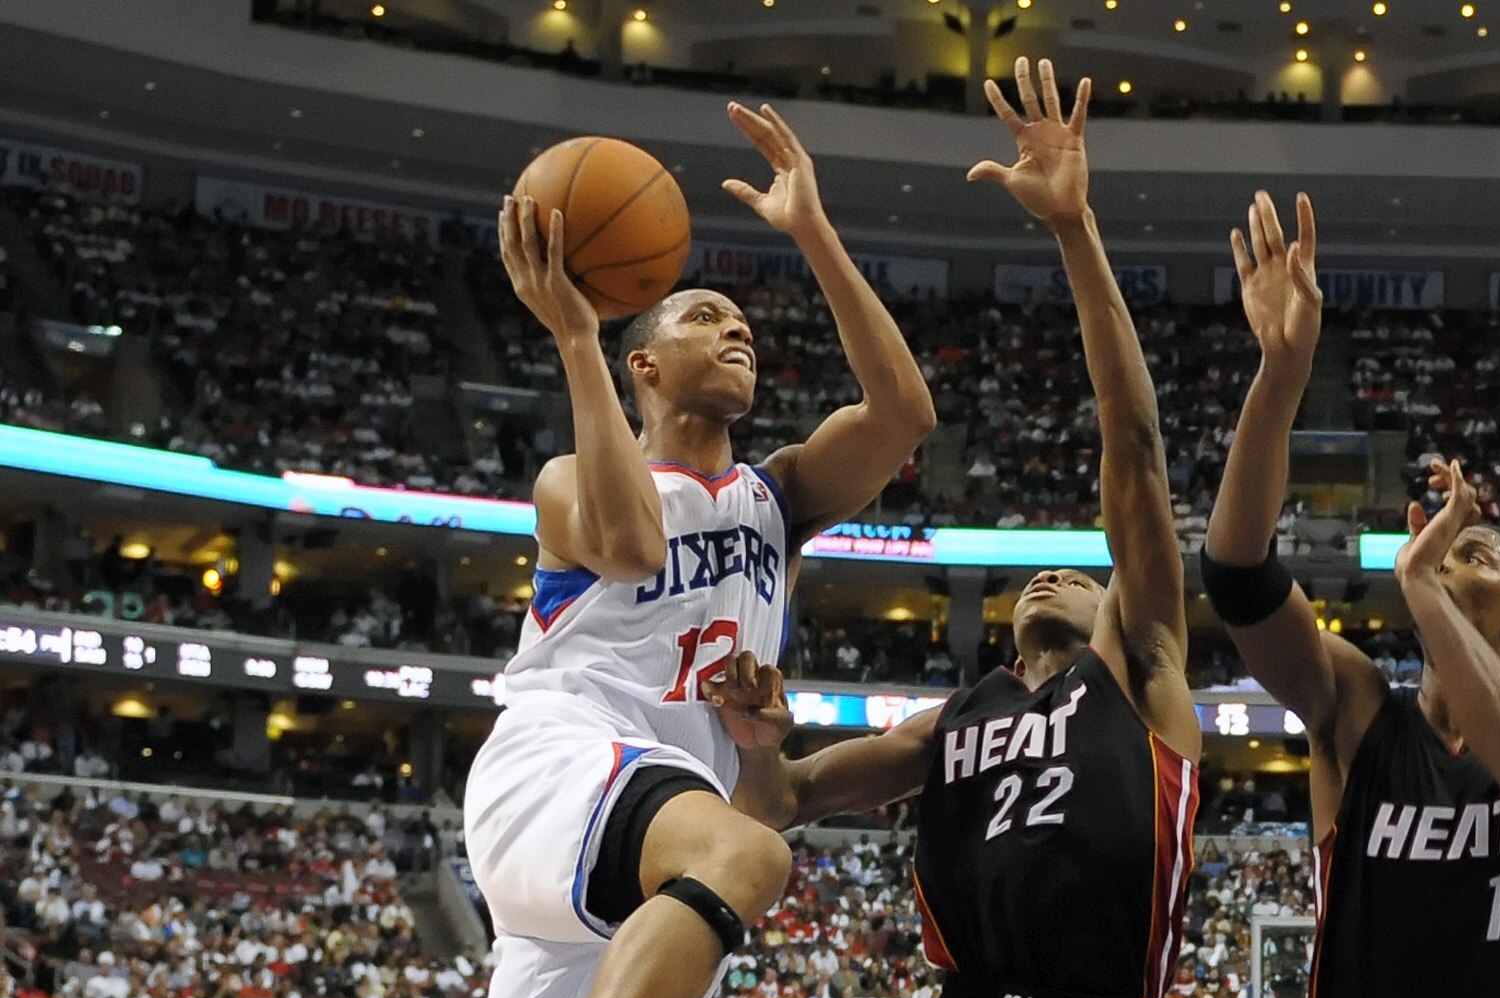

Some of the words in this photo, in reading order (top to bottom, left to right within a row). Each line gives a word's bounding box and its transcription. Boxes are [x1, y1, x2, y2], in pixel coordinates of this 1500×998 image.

[661, 618, 740, 704] 12
[944, 682, 1087, 785] HEAT
[985, 766, 1074, 841] 22
